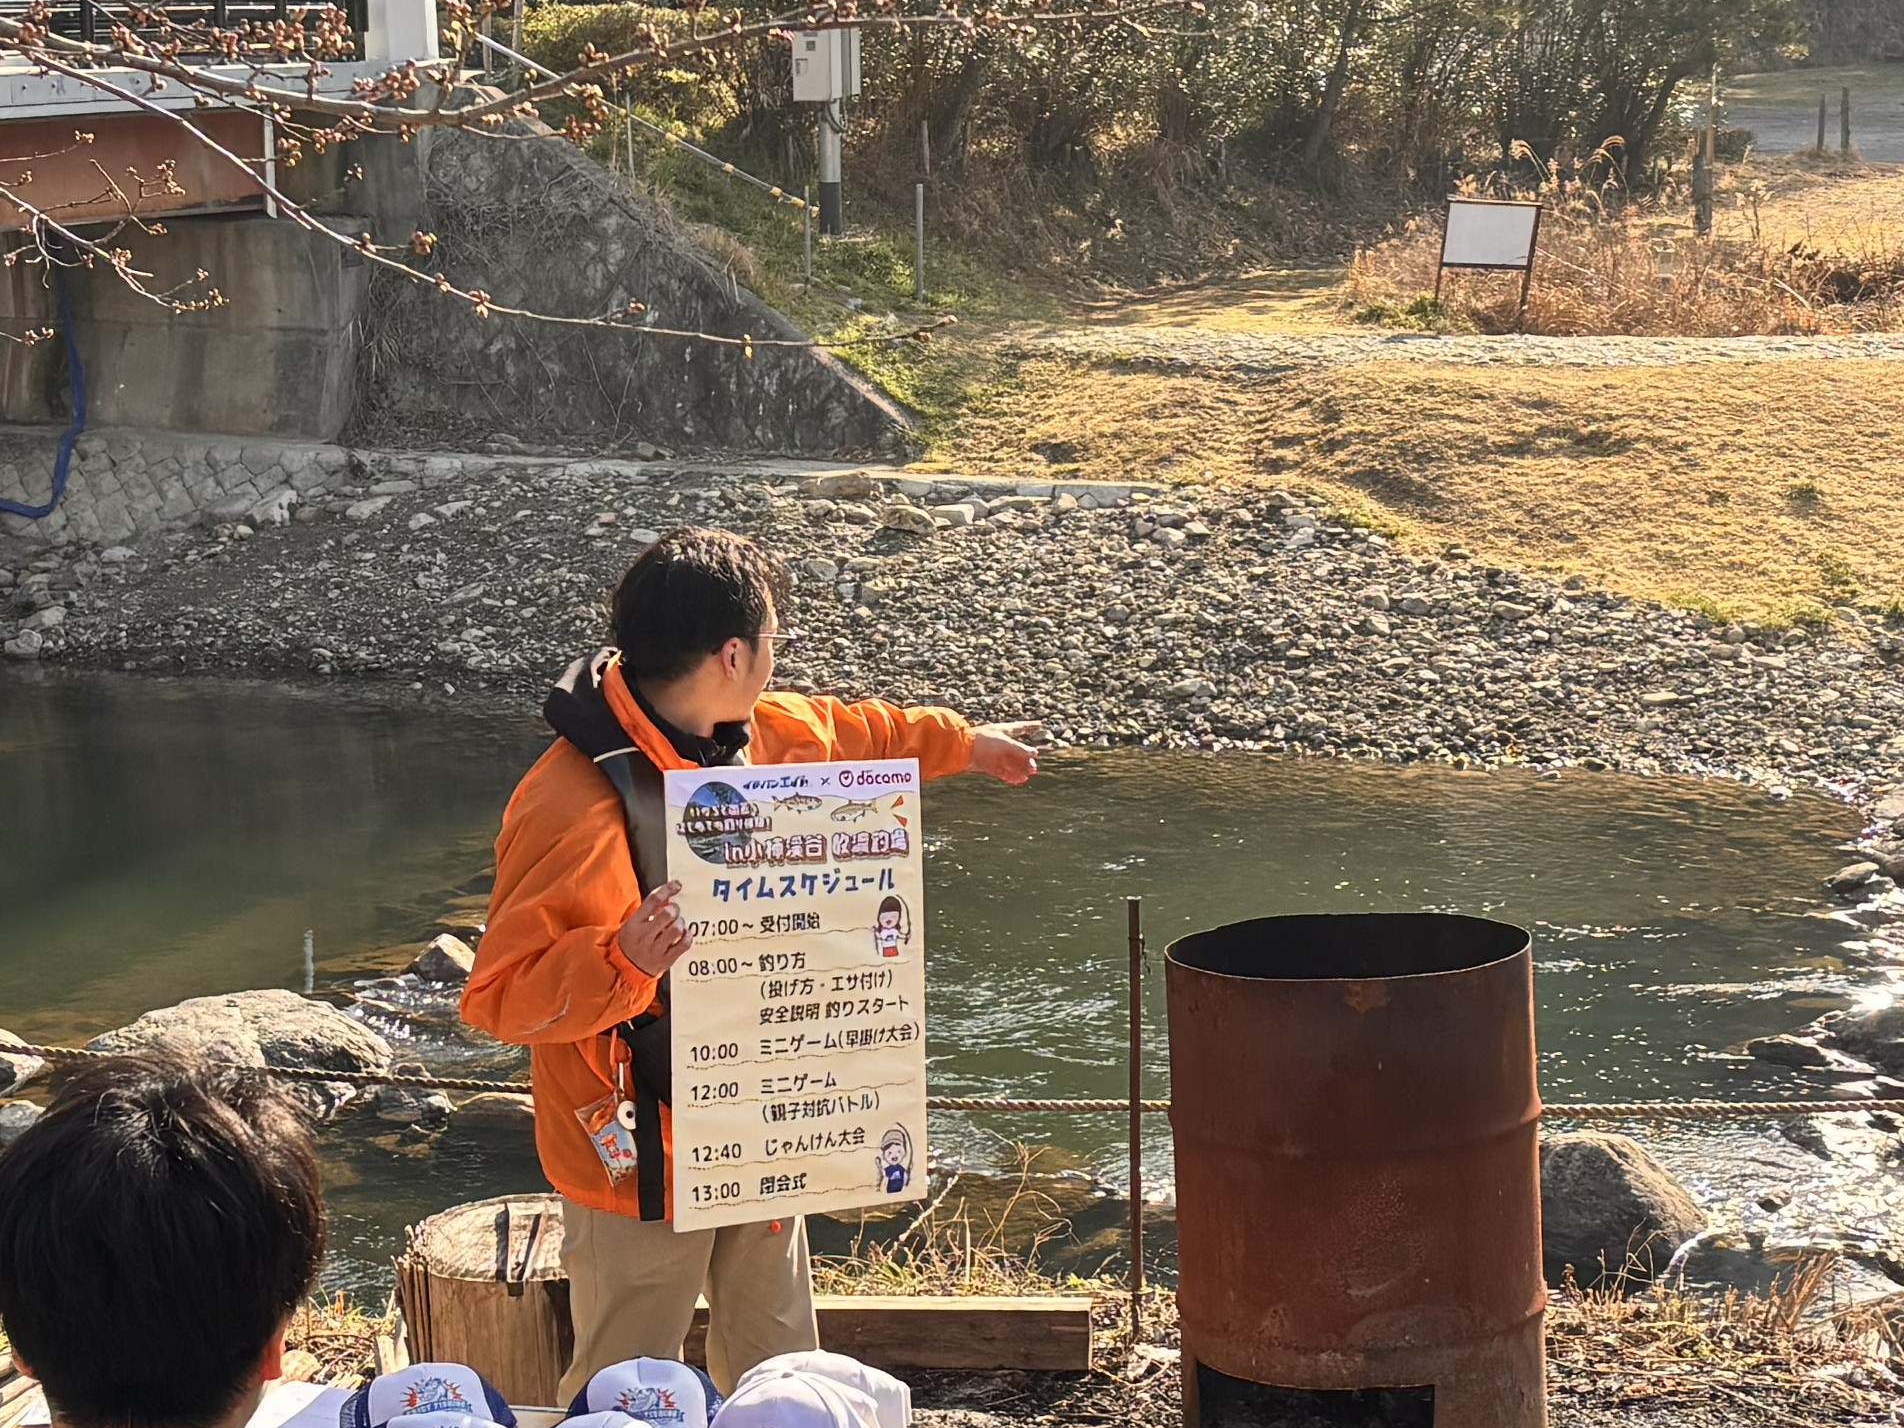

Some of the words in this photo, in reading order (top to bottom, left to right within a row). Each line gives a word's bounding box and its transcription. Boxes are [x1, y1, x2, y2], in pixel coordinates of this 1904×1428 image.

[857, 770, 912, 785] docomo
[712, 868, 896, 903] タイムスケジュール
[760, 912, 821, 934] 受付開始
[759, 952, 806, 972] 釣り方
[690, 1043, 739, 1063] 10:00
[690, 1081, 739, 1102] 12:00
[760, 1072, 838, 1095] ミニゲーム
[691, 1143, 742, 1164] 12:40
[765, 1126, 866, 1156] じゃんけん大会
[691, 1182, 741, 1203] 13:00
[760, 1172, 807, 1195] 閉会式
